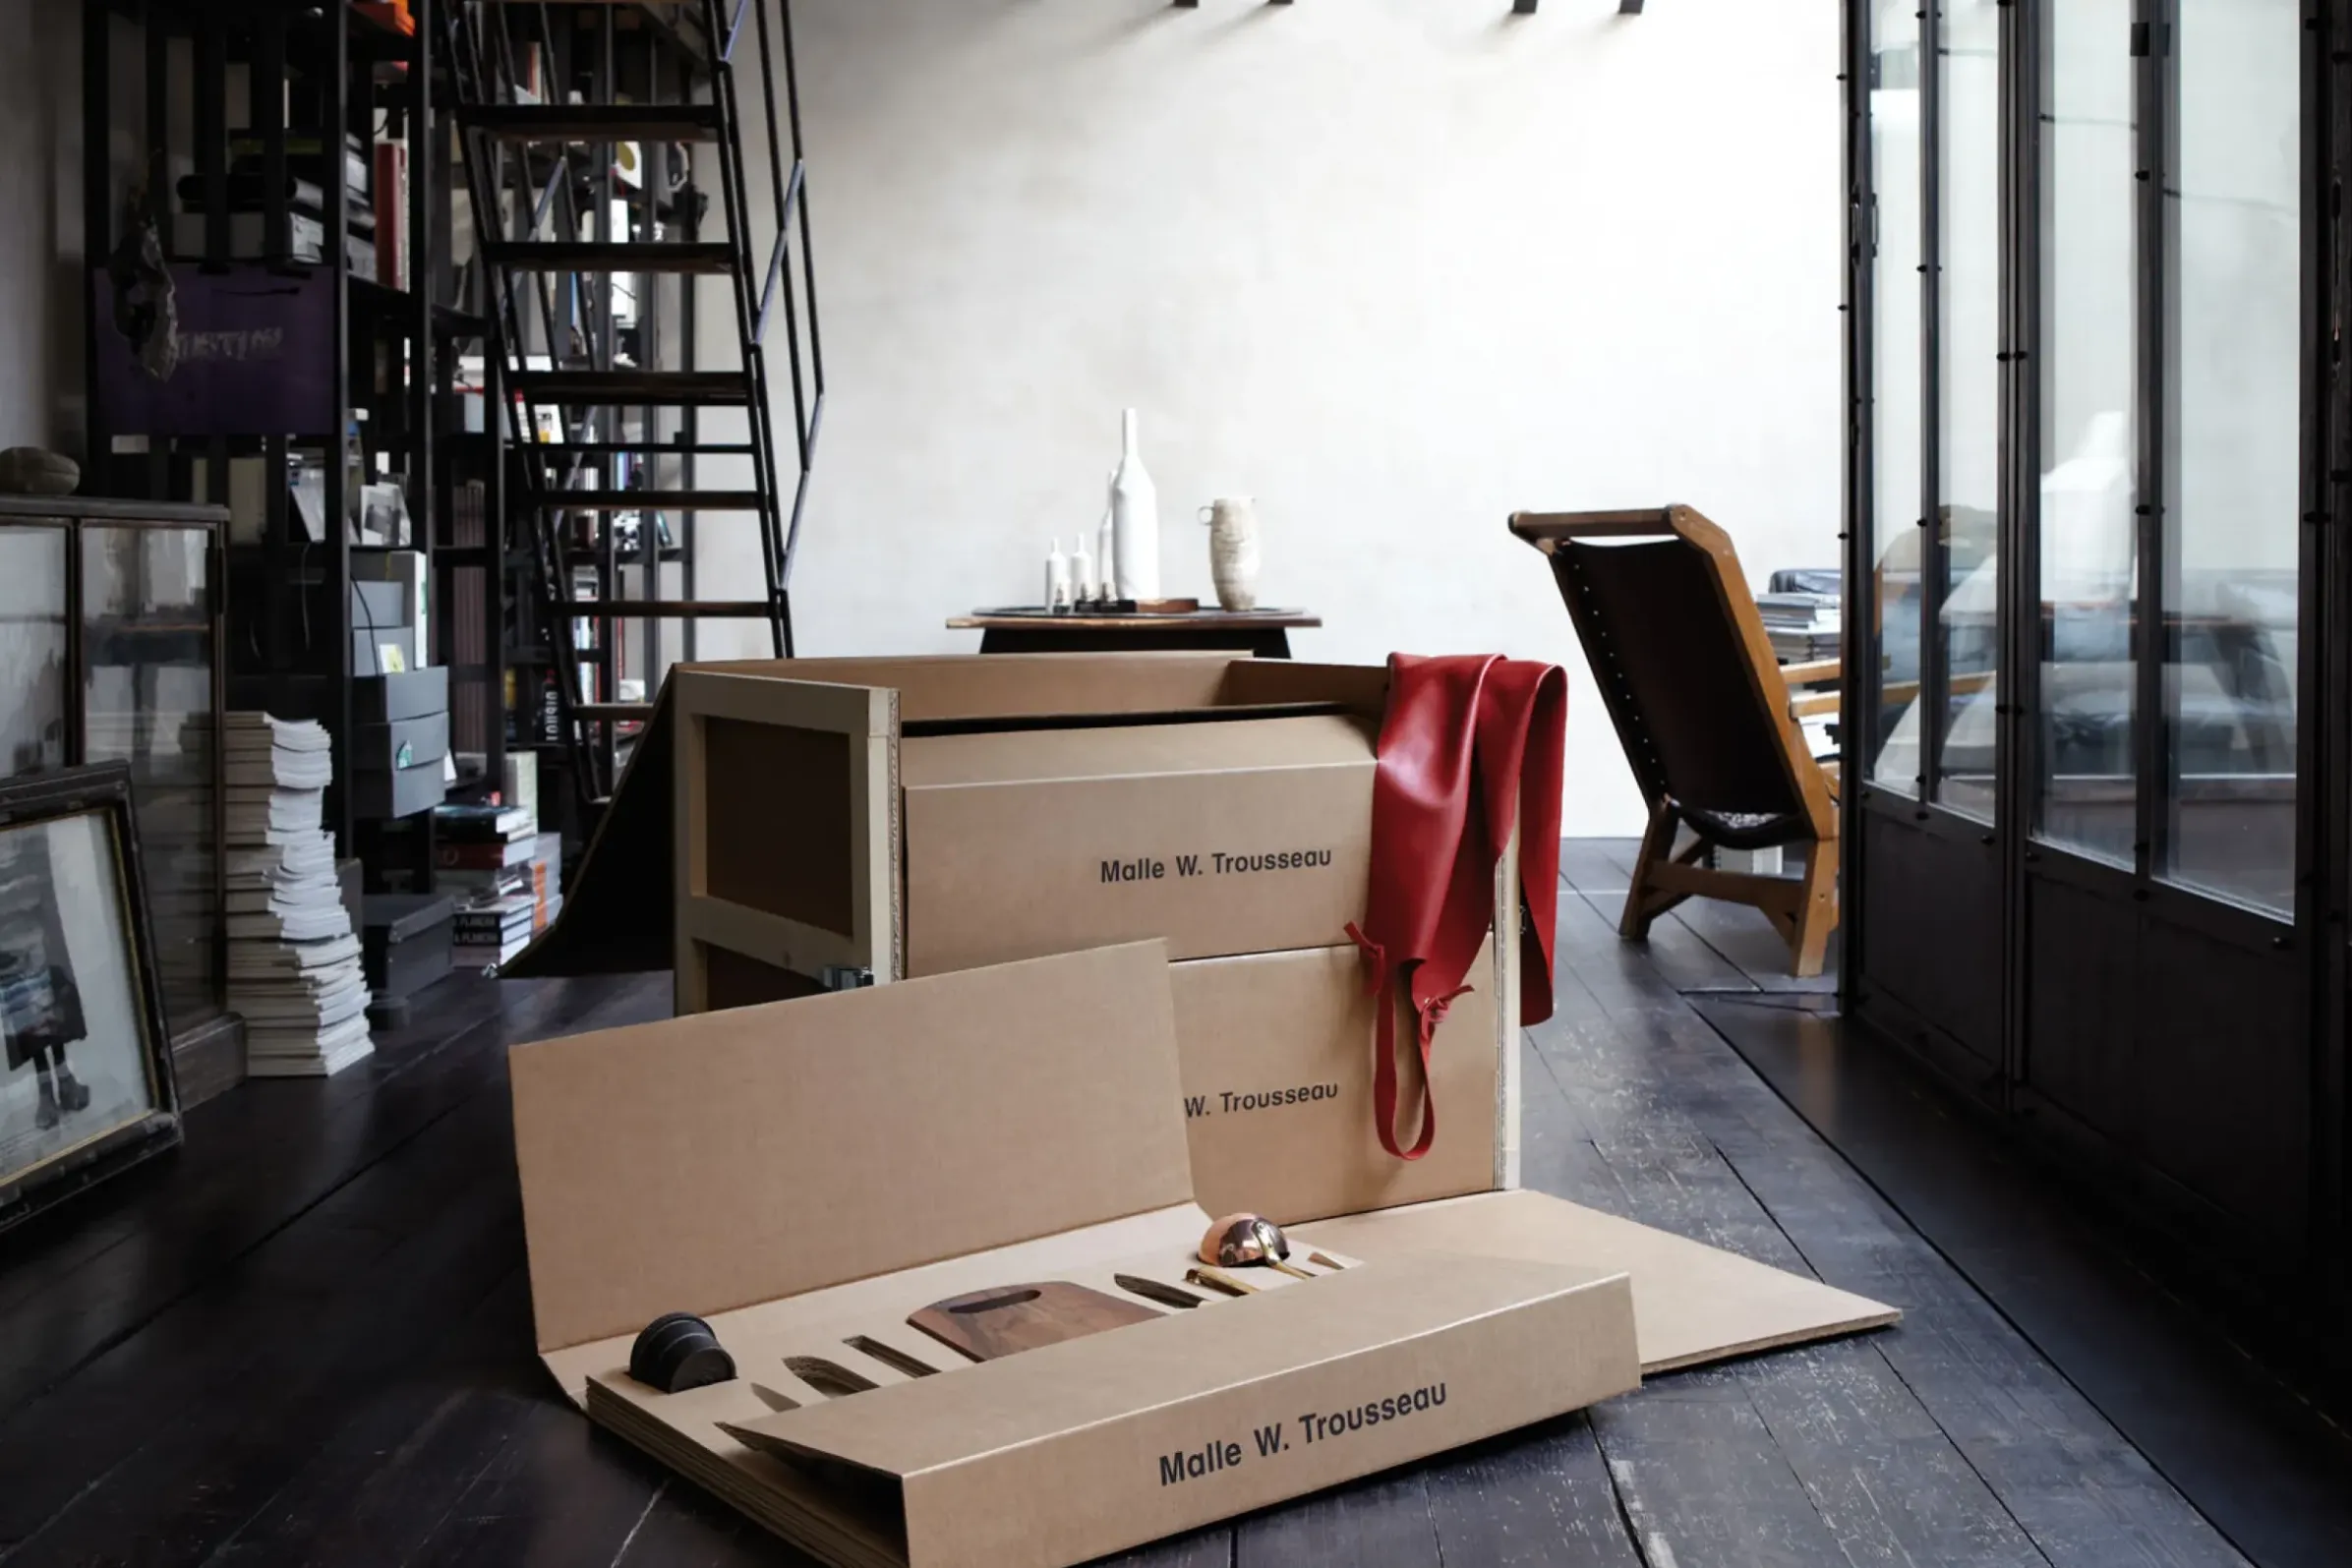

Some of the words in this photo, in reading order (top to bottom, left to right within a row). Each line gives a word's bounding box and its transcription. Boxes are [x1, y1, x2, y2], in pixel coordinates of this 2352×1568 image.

[1100, 857, 1165, 884] Malle
[1175, 853, 1204, 878] W.
[1210, 849, 1332, 875] Trousseau
[1184, 1094, 1211, 1119] W.
[1218, 1082, 1338, 1114] Trousseau
[1158, 1439, 1242, 1487] Malle
[1253, 1422, 1290, 1458] W.
[1297, 1381, 1447, 1445] Trousseau
